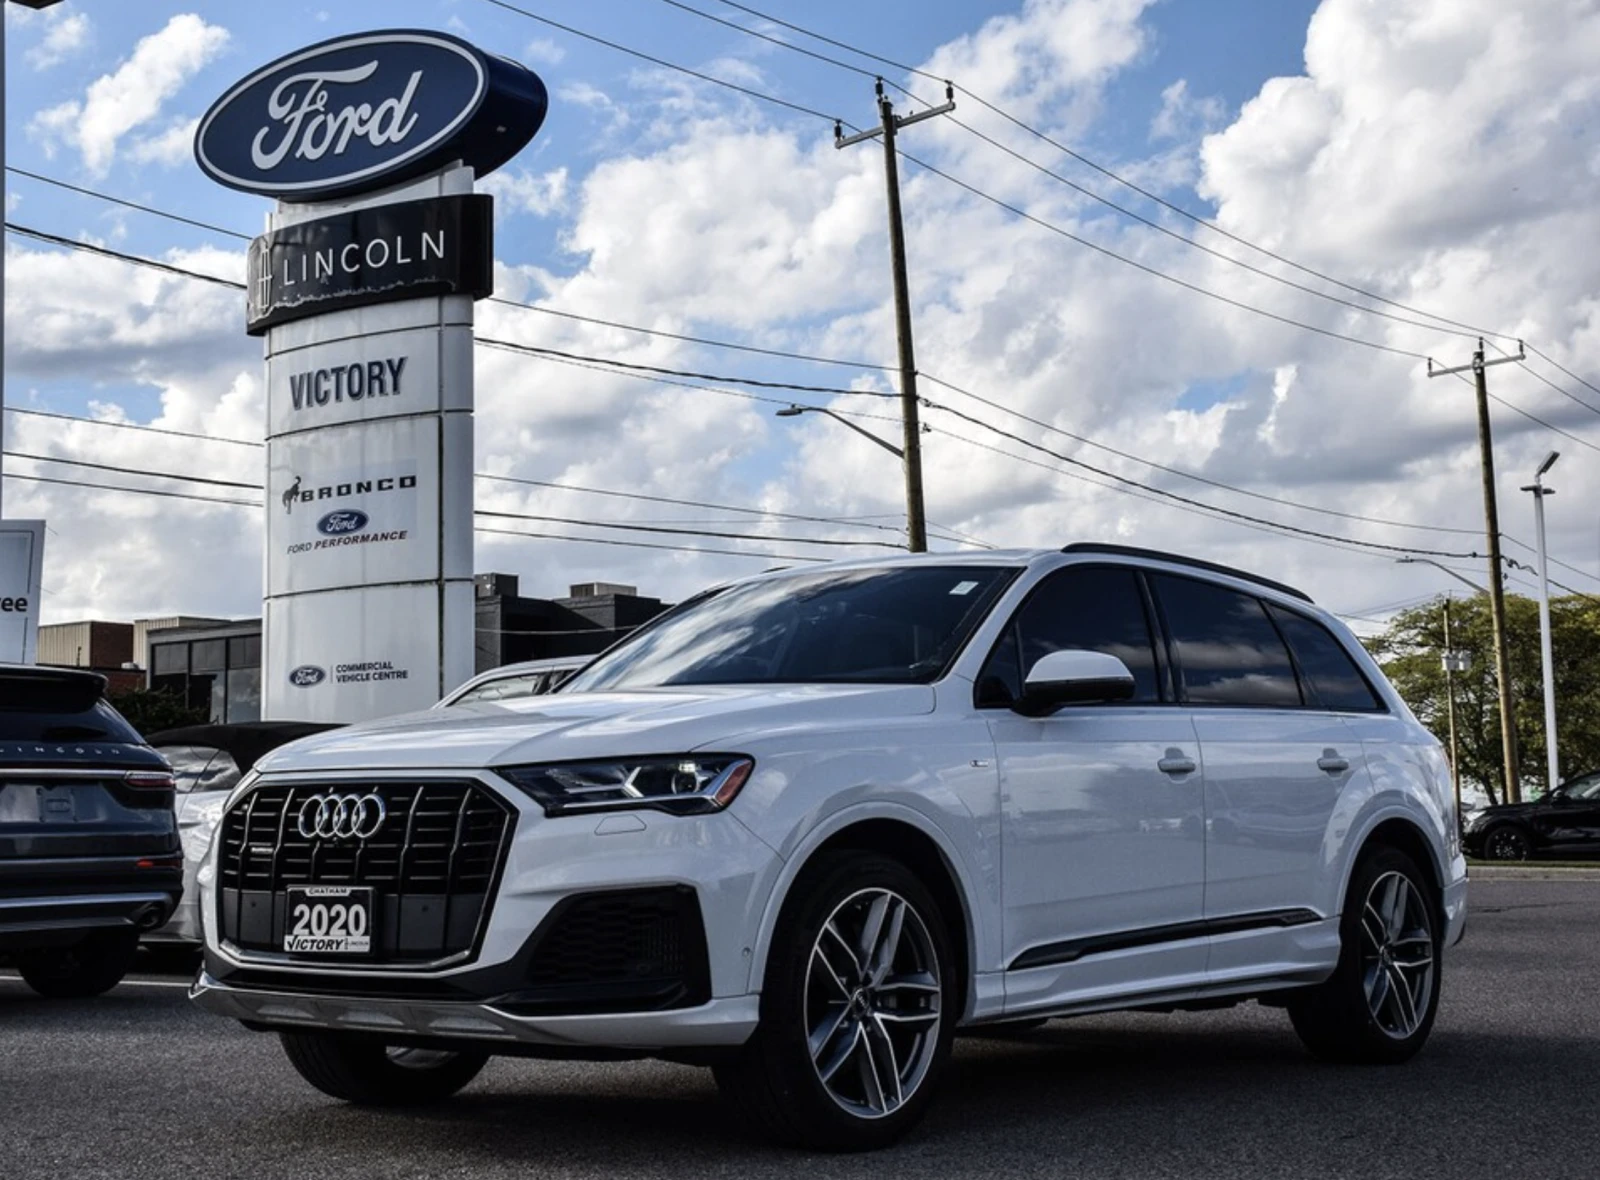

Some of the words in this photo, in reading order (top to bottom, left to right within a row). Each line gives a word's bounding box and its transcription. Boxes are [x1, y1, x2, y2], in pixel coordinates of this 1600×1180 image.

[252, 60, 423, 170] Ford
[283, 230, 445, 287] LINCOLN
[290, 356, 409, 412] VICTORY
[300, 475, 417, 502] BRONCO
[326, 513, 359, 532] Ford
[287, 542, 312, 554] FORD
[314, 530, 408, 550] PERFORMANCE
[0, 597, 28, 612] ee
[295, 669, 320, 684] Ford
[336, 661, 394, 673] COMMERCIAL
[336, 672, 371, 683] VEHICLE
[372, 670, 408, 680] CENTRE
[308, 886, 348, 895] CHATHAM
[292, 903, 367, 937] 2020
[287, 935, 344, 950] VICTORY
